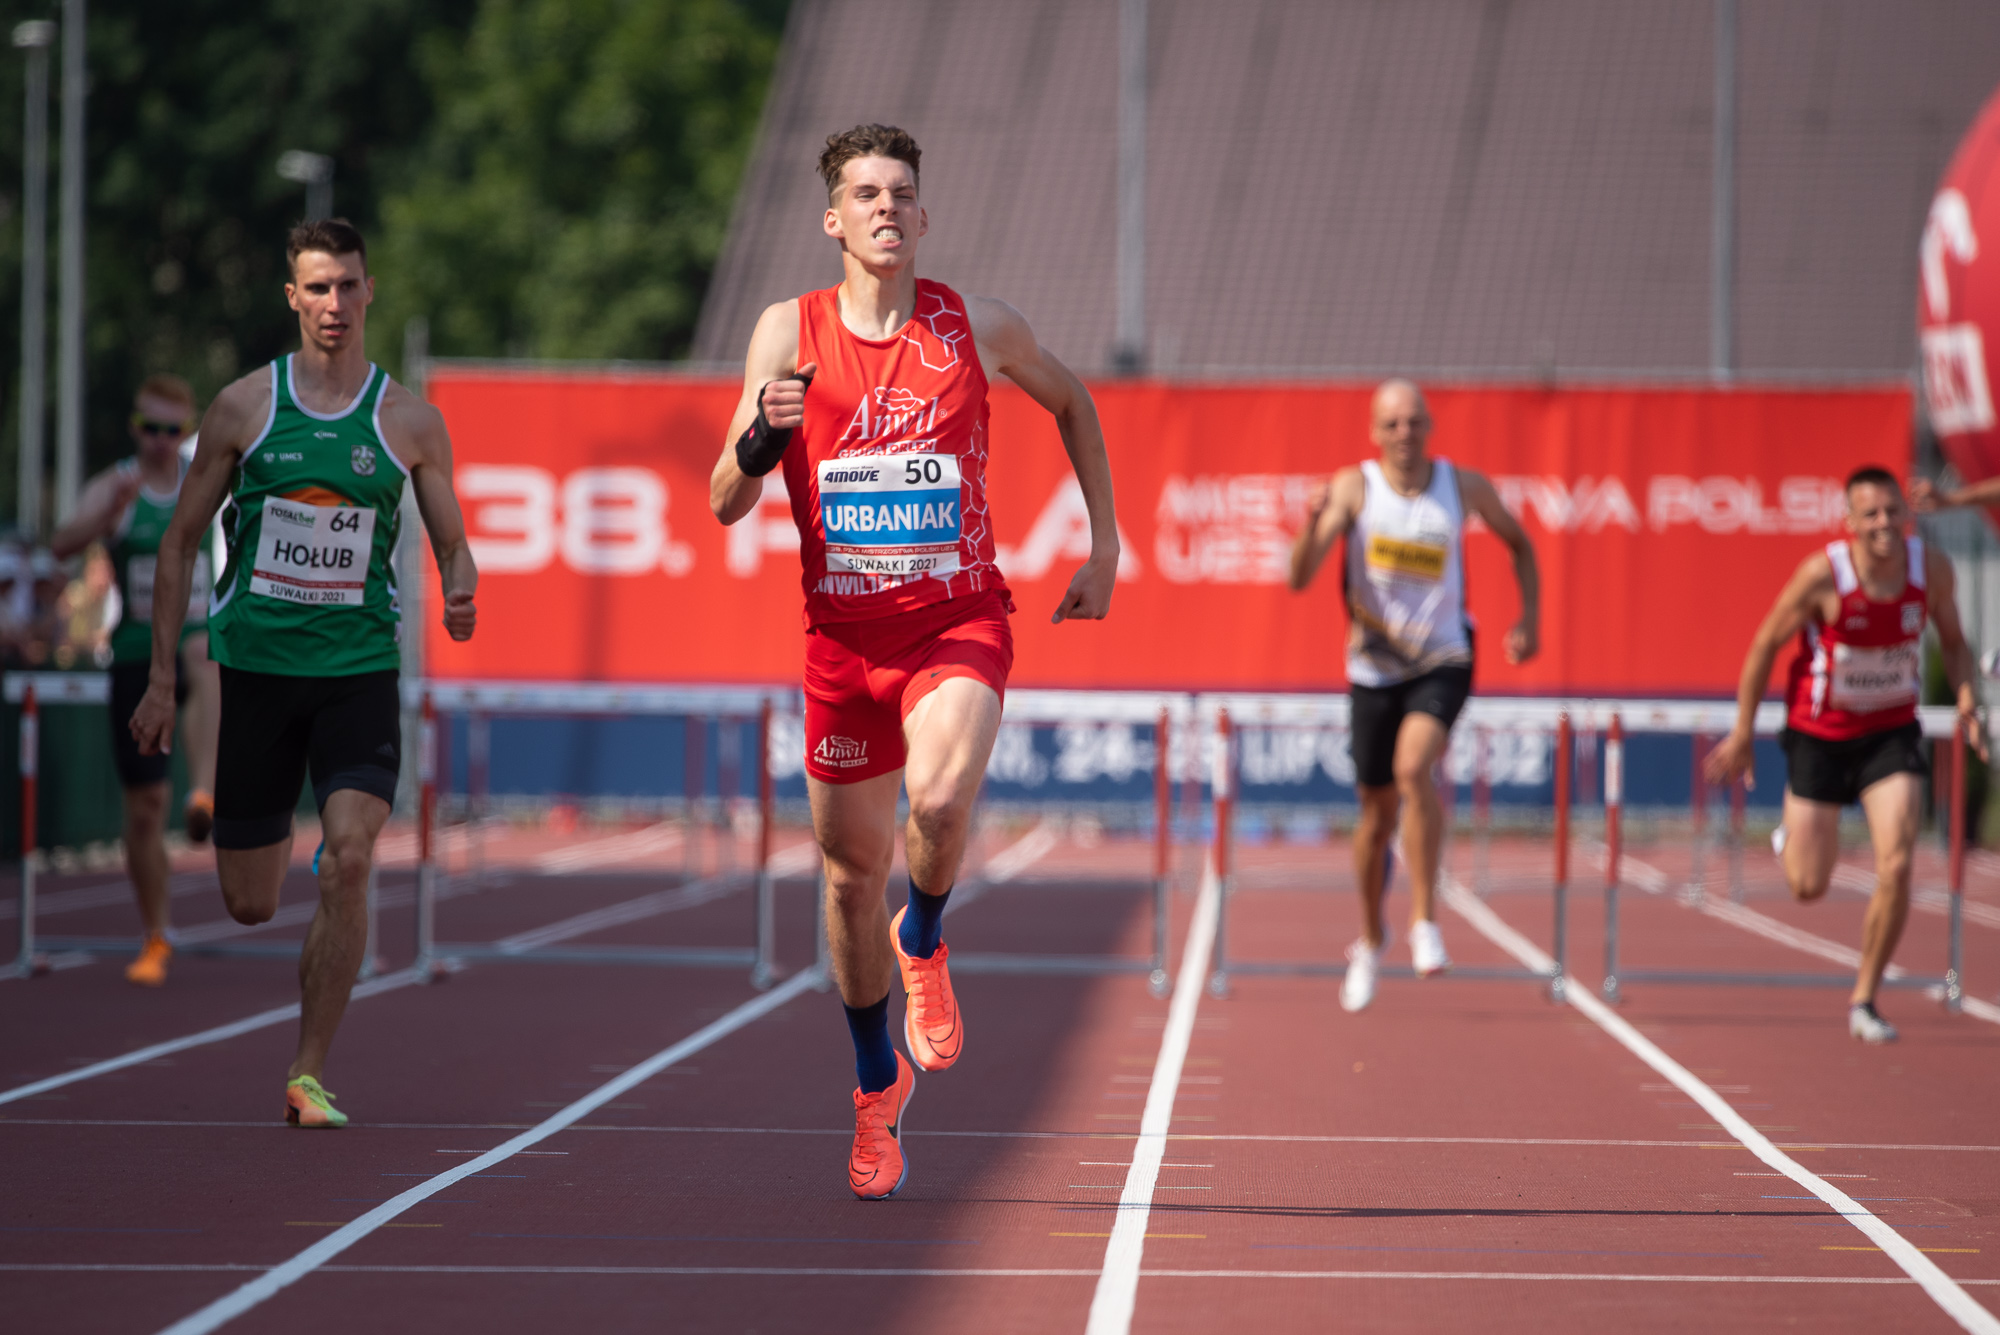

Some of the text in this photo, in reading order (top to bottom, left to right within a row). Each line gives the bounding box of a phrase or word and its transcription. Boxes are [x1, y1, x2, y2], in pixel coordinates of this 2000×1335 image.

[840, 393, 939, 441] Anwil
[279, 452, 303, 462] UMCS
[888, 440, 936, 454] ORLEN
[824, 470, 880, 483] 4MOVE
[905, 459, 942, 484] 50
[330, 511, 360, 533] 64
[455, 464, 695, 577] 38.
[825, 502, 955, 532] URBANIAK
[273, 539, 354, 569] HOŁUB
[848, 558, 937, 572] SUWAŁKI 2021
[269, 584, 345, 602] SUWAŁKI 2021
[814, 736, 867, 759] Anwil
